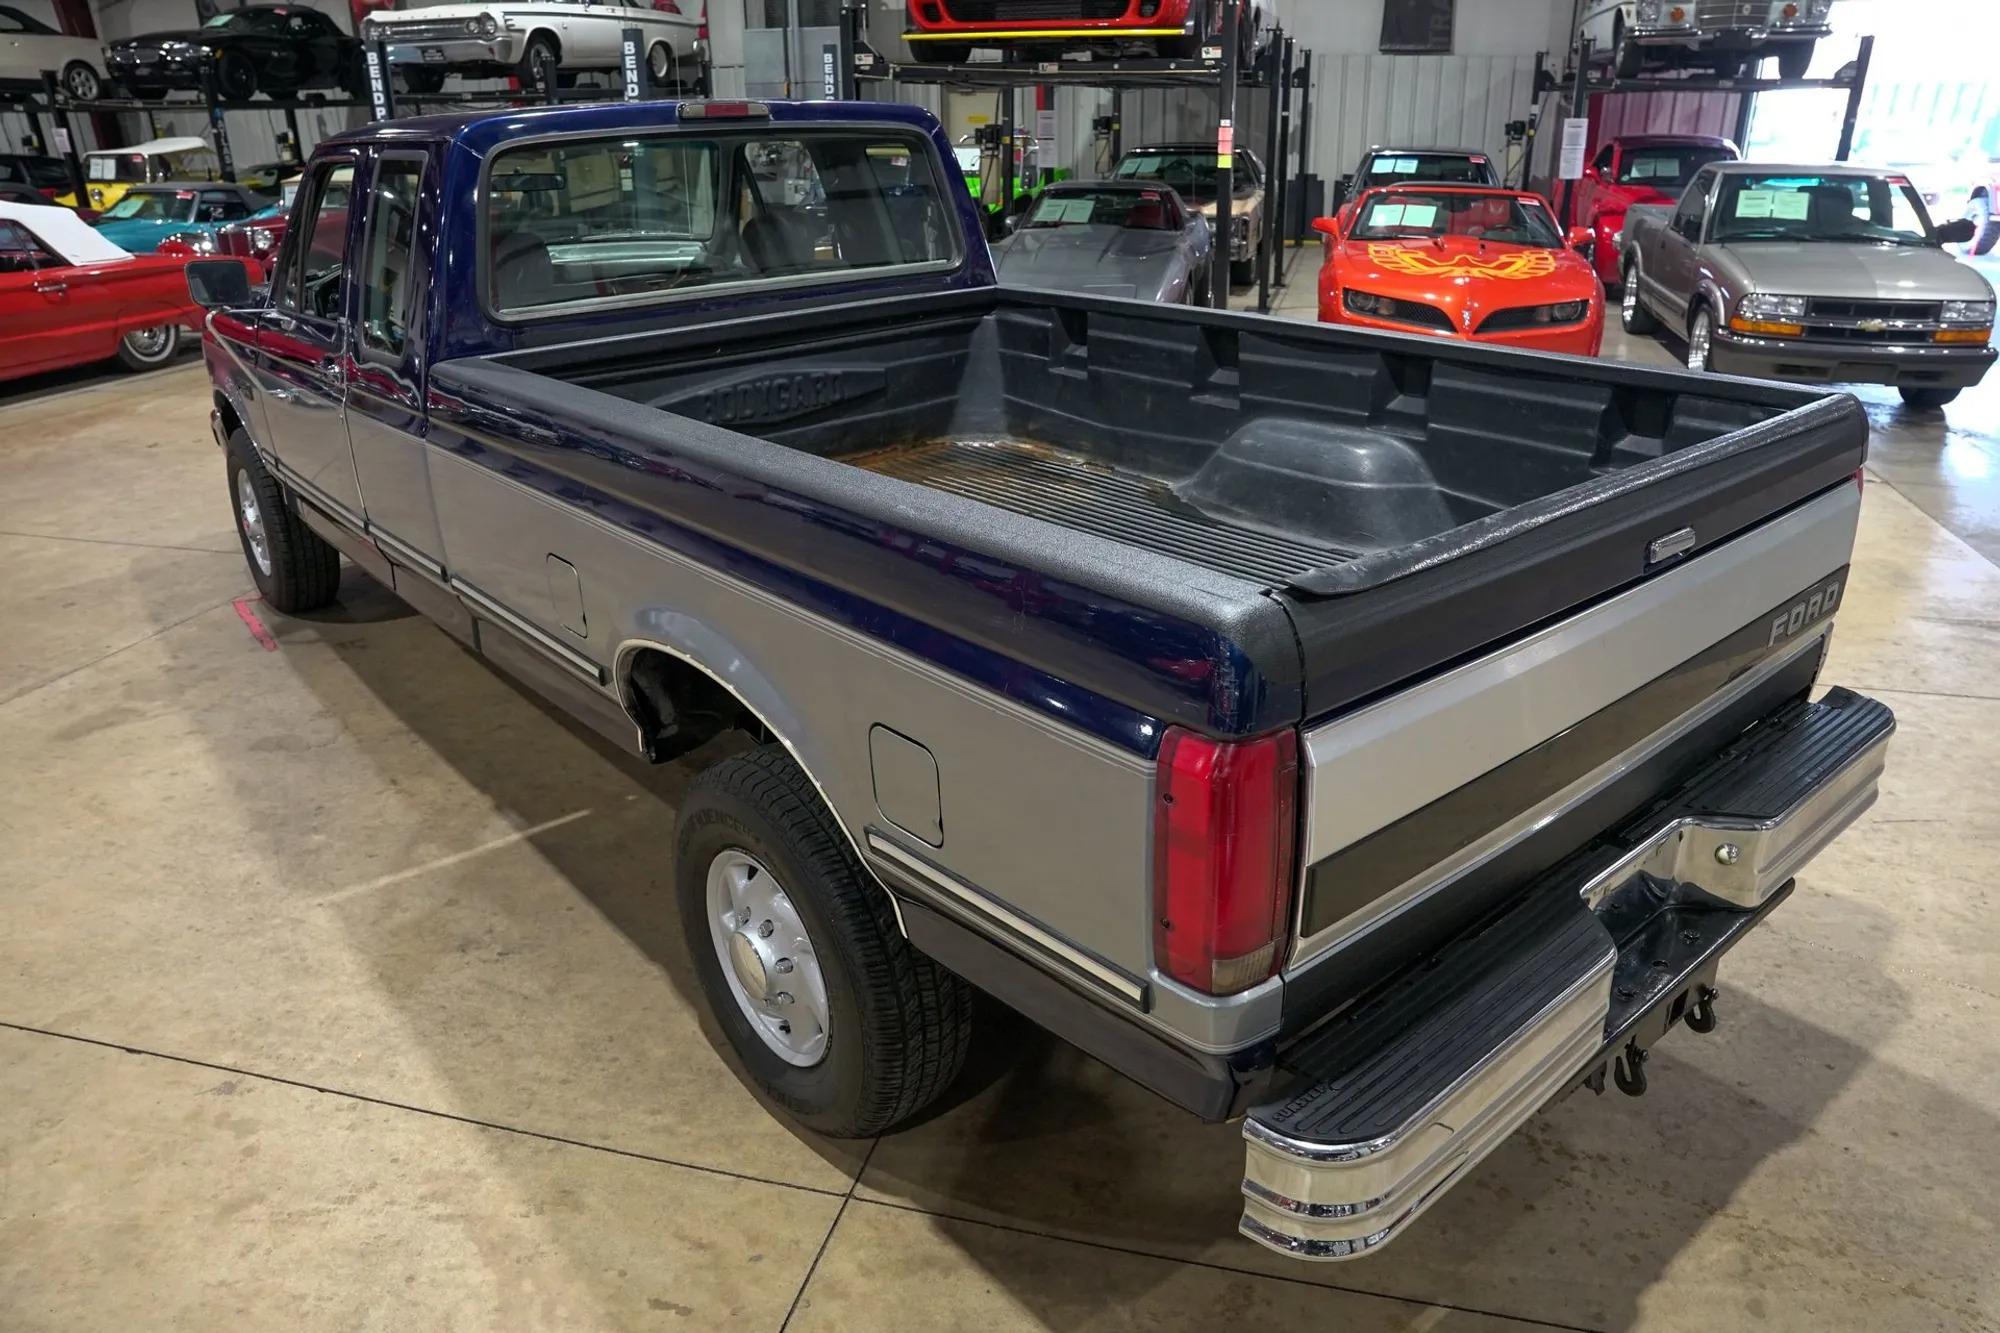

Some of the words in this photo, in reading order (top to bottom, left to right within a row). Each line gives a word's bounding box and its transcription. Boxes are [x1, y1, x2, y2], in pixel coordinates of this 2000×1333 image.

[367, 51, 387, 122] BENDP
[623, 41, 640, 102] BEND
[1768, 580, 1839, 648] FORD
